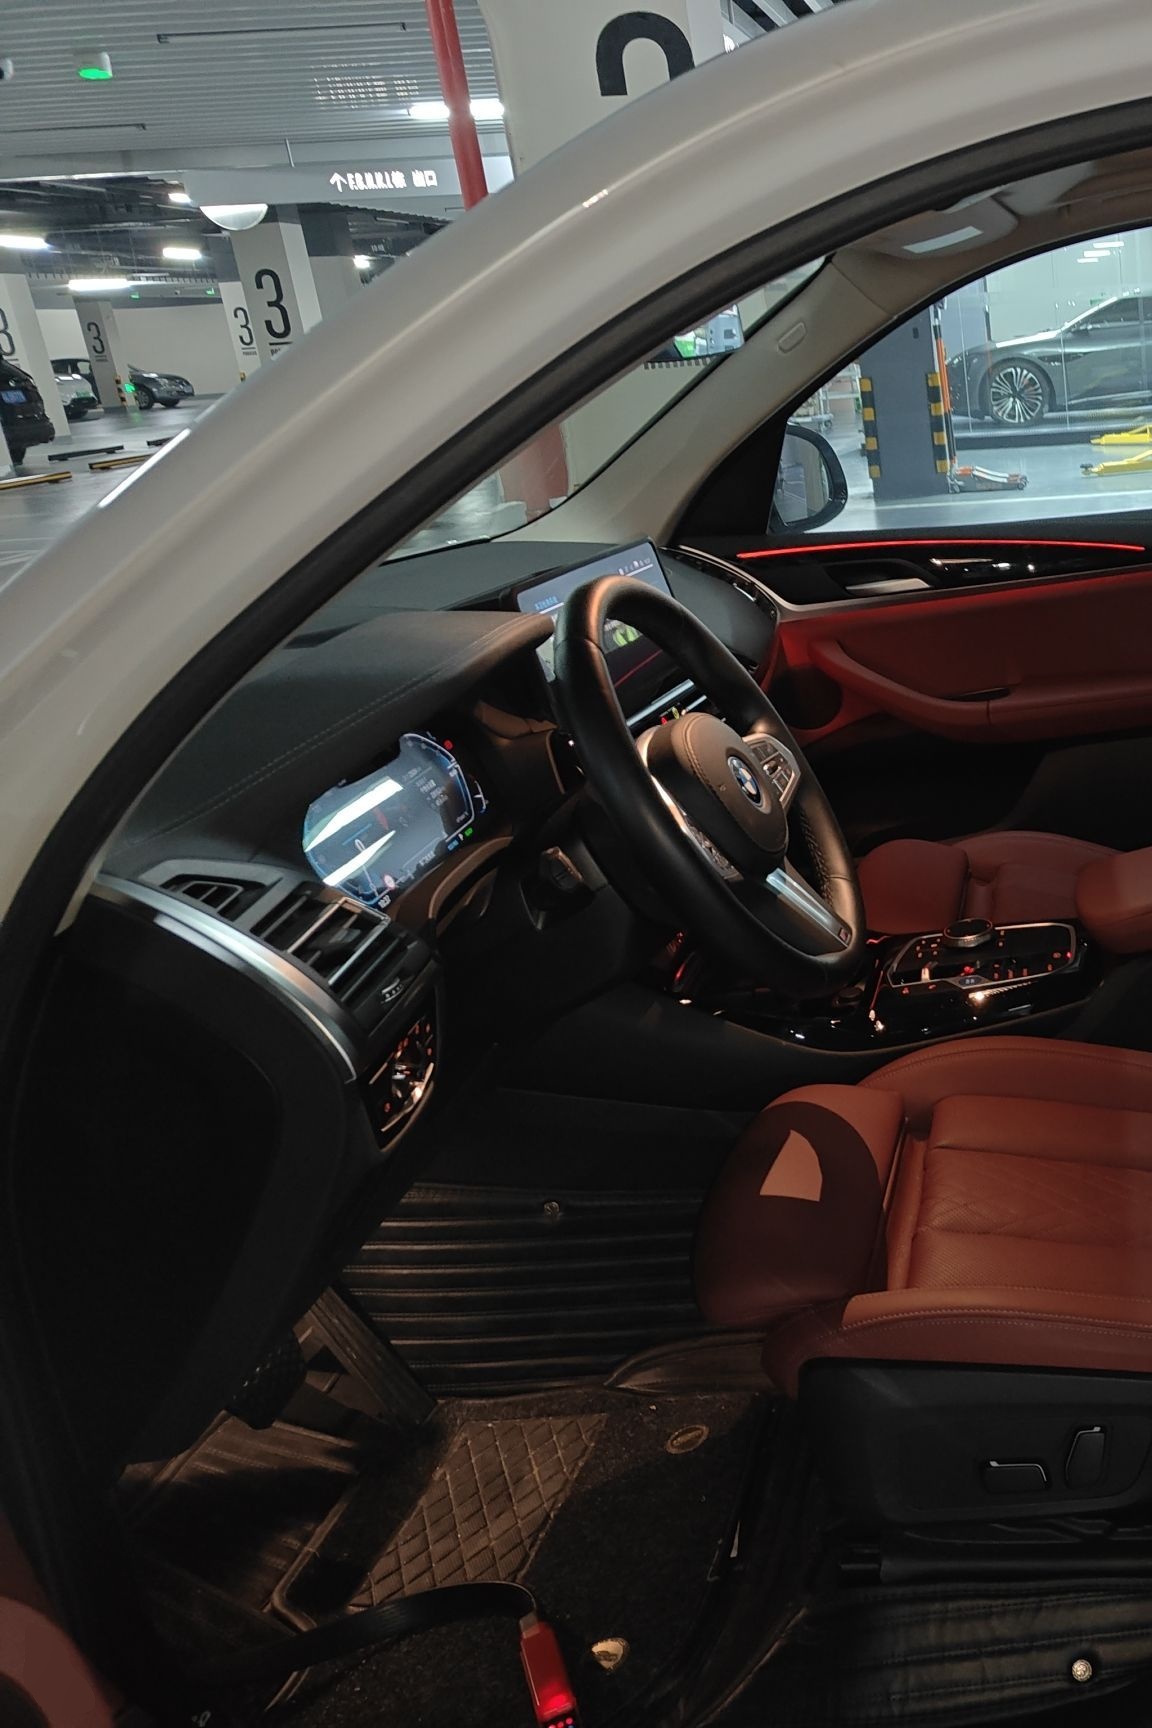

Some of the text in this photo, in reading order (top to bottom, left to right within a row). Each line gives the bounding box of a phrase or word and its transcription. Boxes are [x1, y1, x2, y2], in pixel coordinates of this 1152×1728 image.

[255, 268, 291, 338] 3
[87, 322, 105, 354] 3
[233, 307, 254, 346] 3
